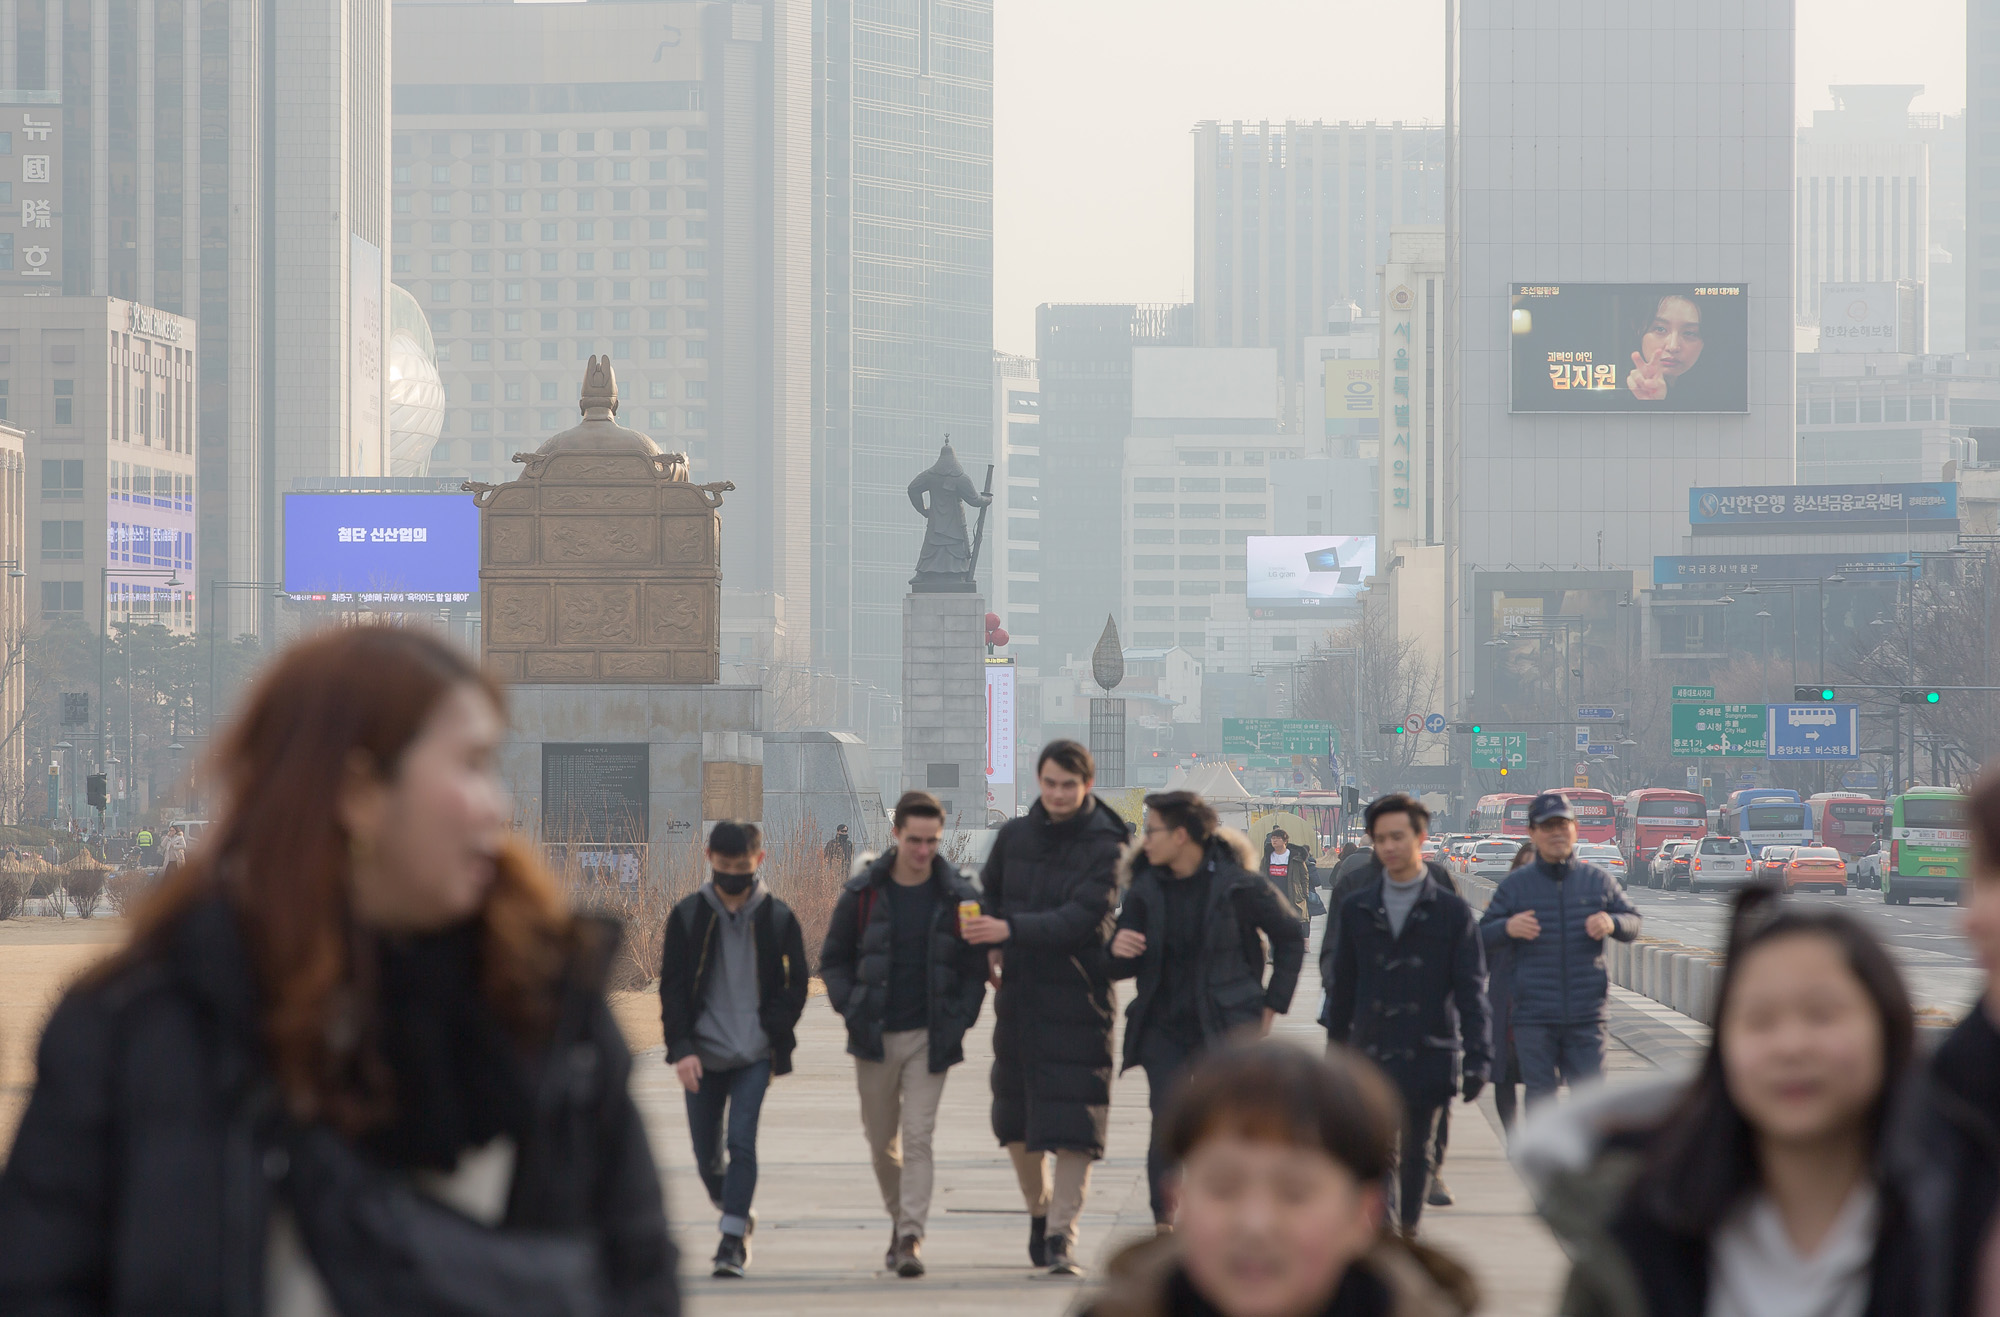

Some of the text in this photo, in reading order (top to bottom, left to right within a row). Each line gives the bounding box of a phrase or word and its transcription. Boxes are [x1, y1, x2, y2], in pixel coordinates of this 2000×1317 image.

[21, 113, 53, 296] 뉴國際호
[1694, 287, 1740, 296] 2월 8일 대개봉
[1824, 325, 1893, 338] 한화손해보험
[1547, 351, 1593, 363] 괴력의 여인
[1549, 363, 1616, 390] 김지원
[1393, 321, 1410, 509] 서울특별시의회
[1719, 493, 1947, 515] 신한은행 청소년금융교육센터 광화문캠퍼스
[337, 527, 427, 542] 첨단 신산업의
[1677, 563, 1759, 574] 한국금융사박물관
[1279, 571, 1296, 579] gram
[1677, 688, 1712, 698] 세종대로사거리
[1698, 707, 1722, 716] 숭례문
[1707, 722, 1722, 731] 시청
[1475, 735, 1521, 747] 종로1가
[1673, 738, 1703, 747] 종로1가
[1744, 739, 1767, 748] 서대문
[1475, 747, 1493, 755] Jongno
[1777, 745, 1849, 755] 중앙차로 버스전용
[1585, 806, 1603, 815] 5500-2
[1673, 806, 1689, 815] 9401
[1867, 807, 1884, 816] 1200
[1783, 814, 1799, 823] 401
